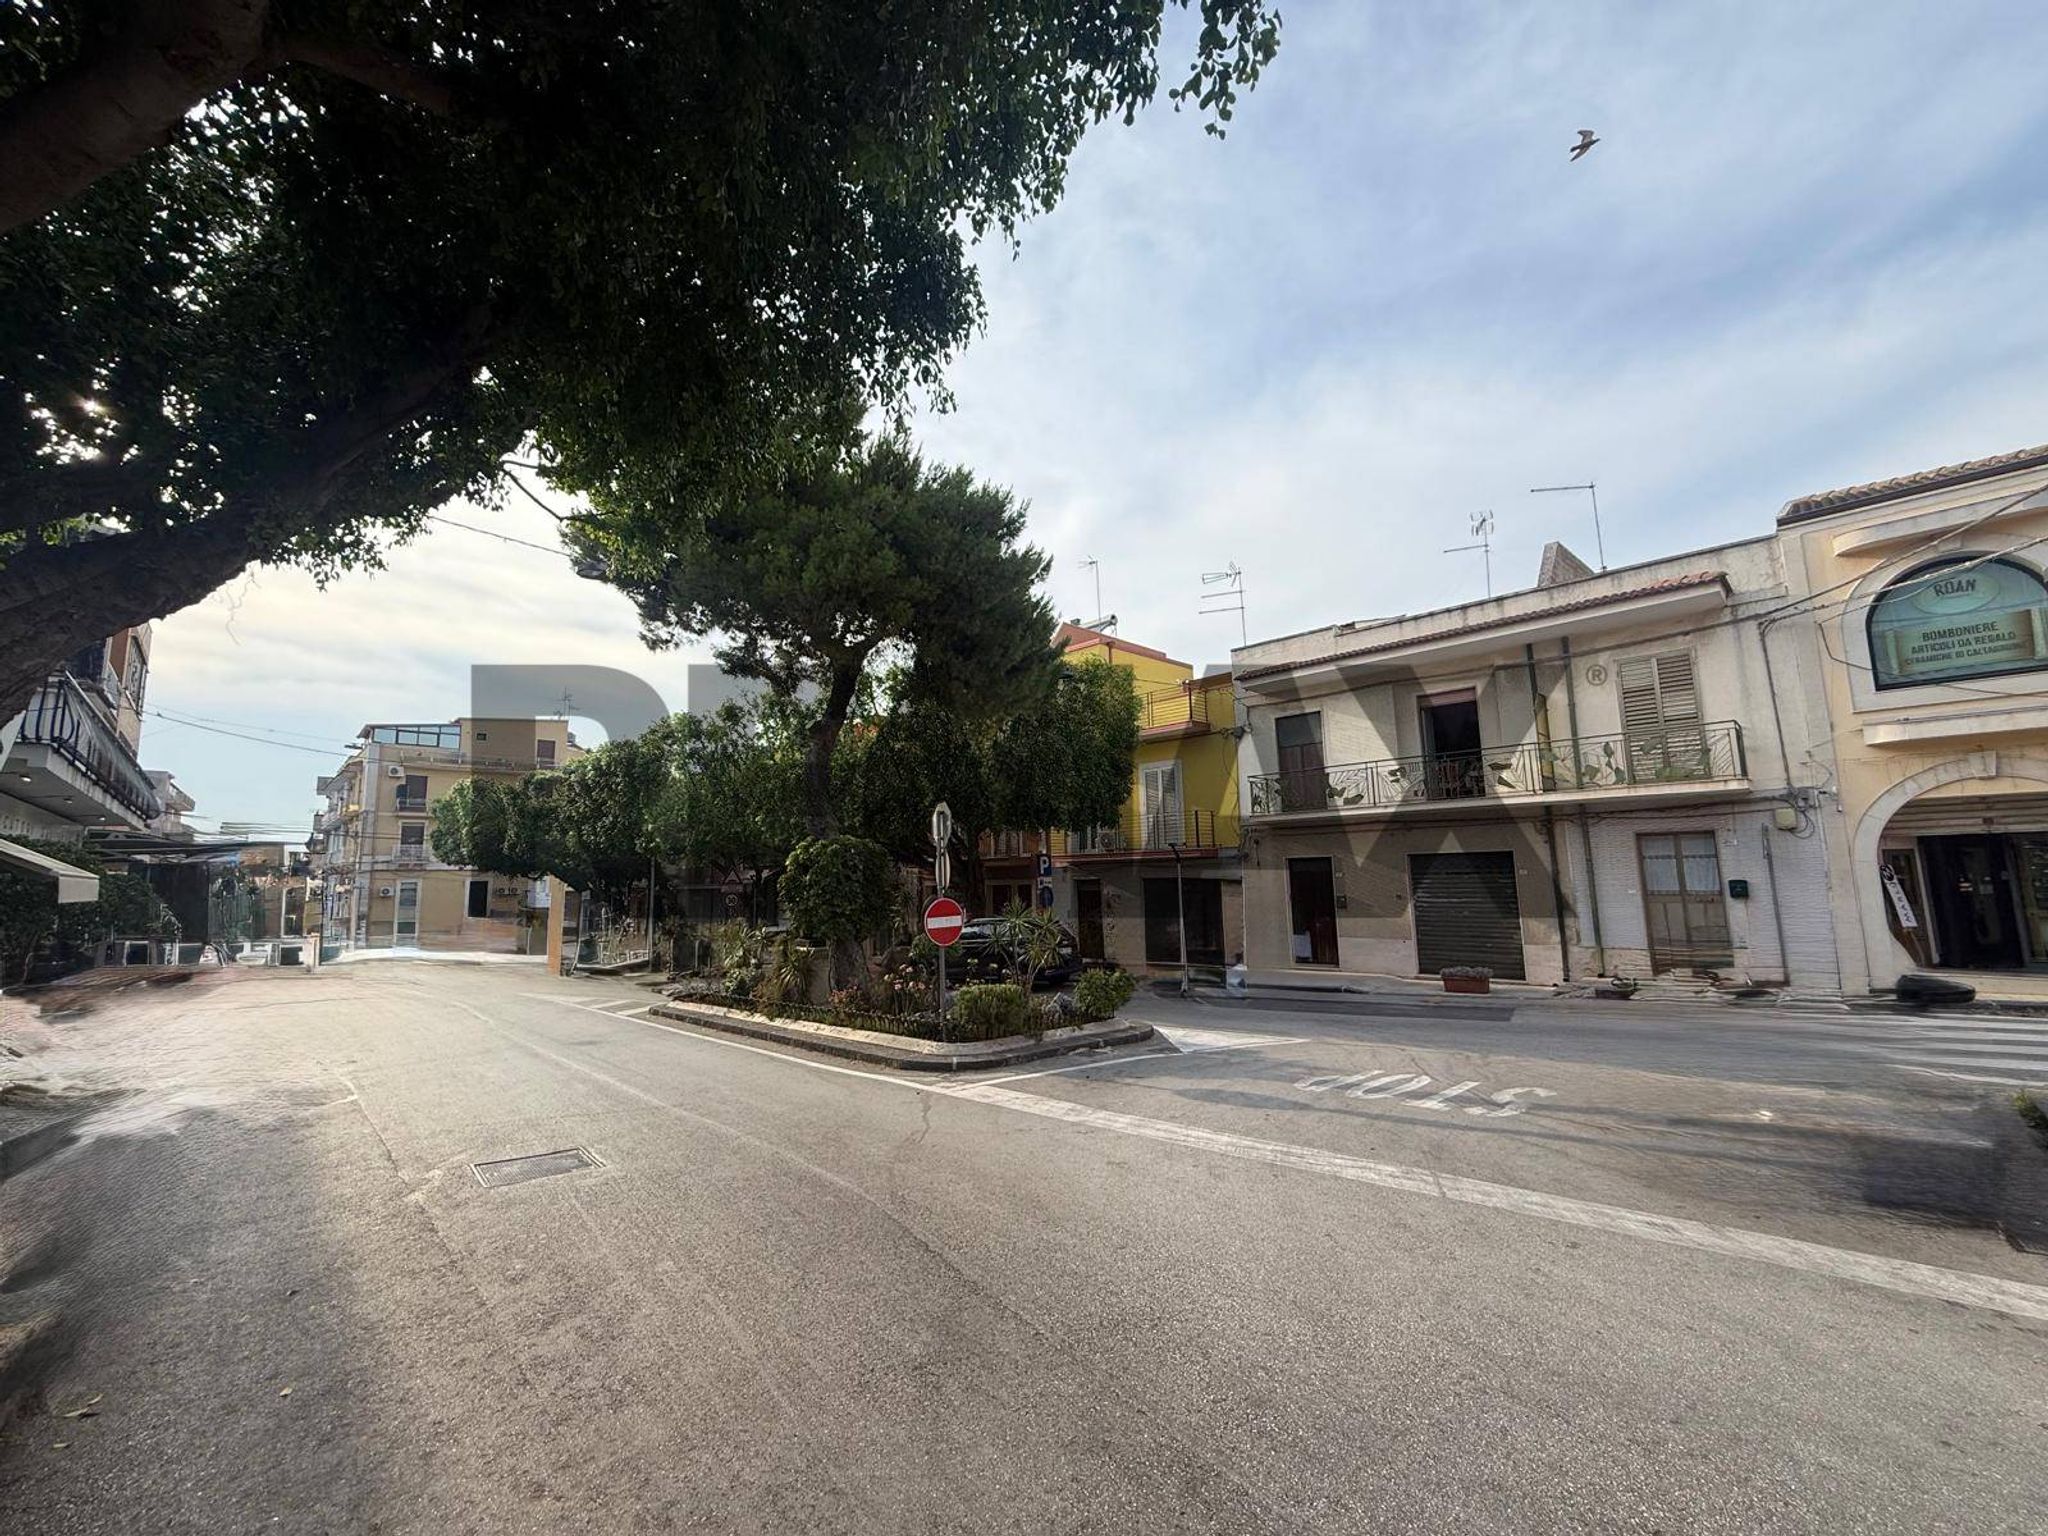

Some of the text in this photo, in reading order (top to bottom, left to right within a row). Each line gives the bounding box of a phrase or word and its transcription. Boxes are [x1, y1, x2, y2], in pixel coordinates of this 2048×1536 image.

[1911, 631, 2017, 655] ARTICOLI DA REGALO
[1922, 621, 1999, 643] BOMBONIERE
[1039, 855, 1050, 875] P
[1293, 1069, 1558, 1118] STOP
